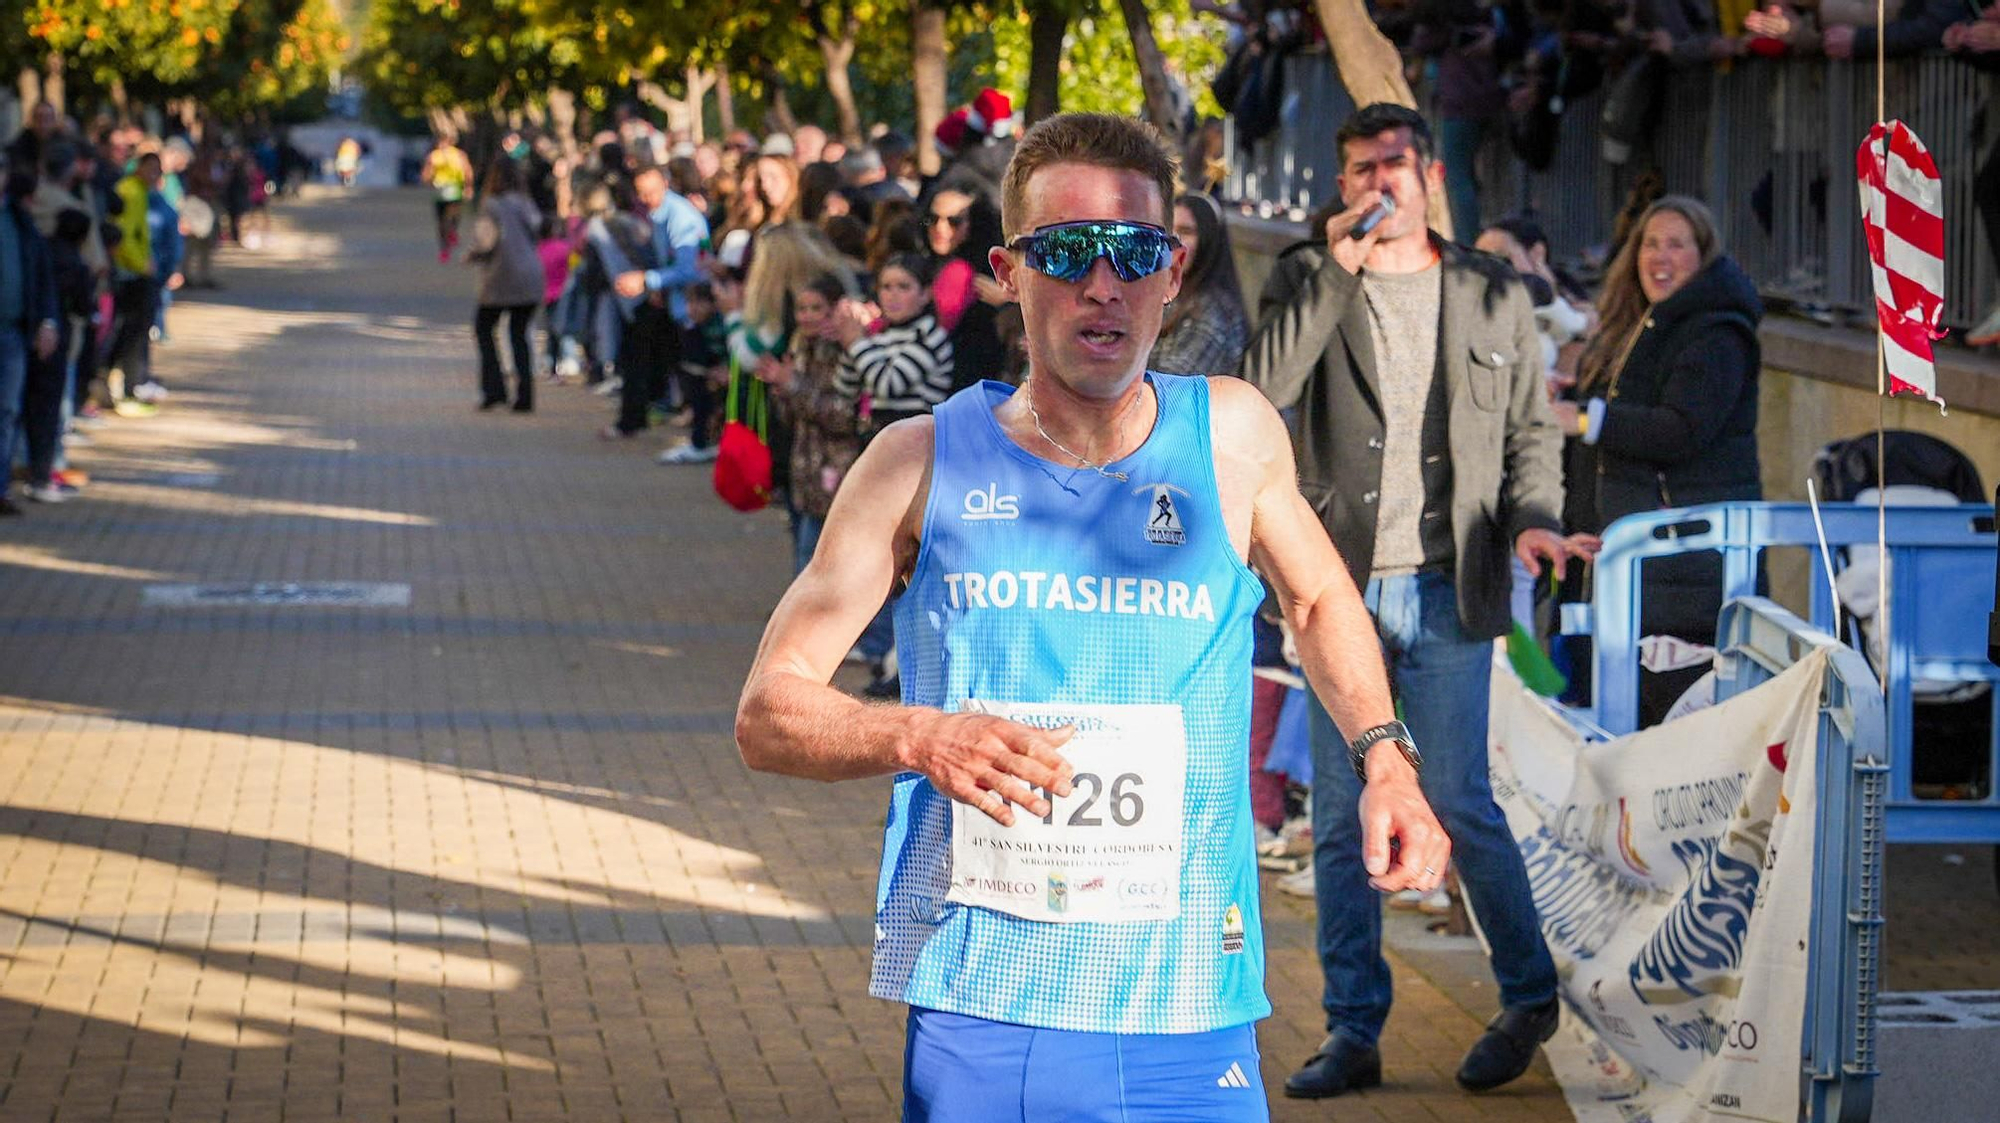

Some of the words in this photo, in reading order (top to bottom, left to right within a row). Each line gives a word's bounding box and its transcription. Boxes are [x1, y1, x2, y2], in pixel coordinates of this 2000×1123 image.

[961, 482, 1020, 520] als
[943, 570, 1215, 623] TROTASIERRA
[989, 838, 1013, 852] SAN
[1015, 841, 1088, 855] SILVESTRE
[1093, 843, 1174, 855] CORDOBESA
[979, 877, 1037, 895] IMDECO
